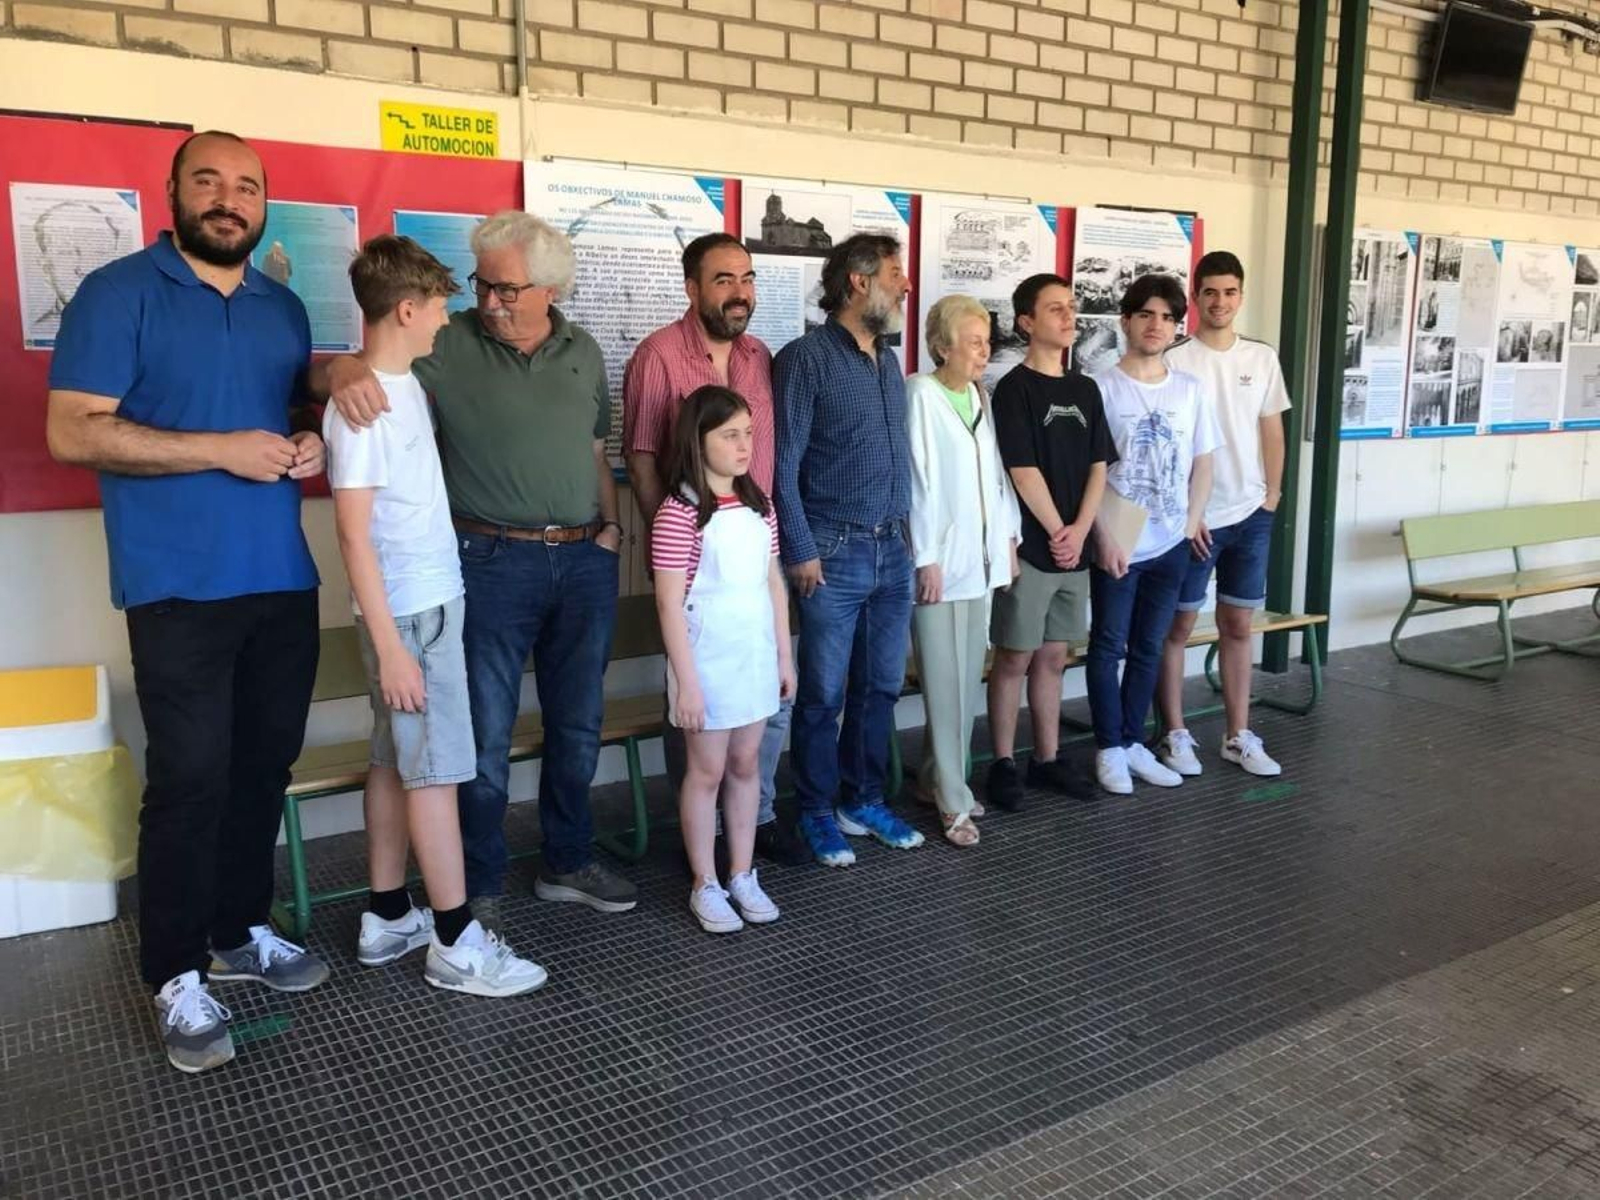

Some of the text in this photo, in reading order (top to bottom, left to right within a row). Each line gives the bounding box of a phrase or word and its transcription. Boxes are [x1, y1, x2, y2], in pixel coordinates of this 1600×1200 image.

[421, 113, 493, 134] TALLER DE
[403, 134, 494, 157] AUTOMOCION
[547, 184, 559, 193] OS
[561, 185, 613, 197] OBXECTIVOS
[614, 189, 625, 198] DE
[626, 190, 661, 201] MANUEL
[662, 192, 702, 204] CHAMOSO
